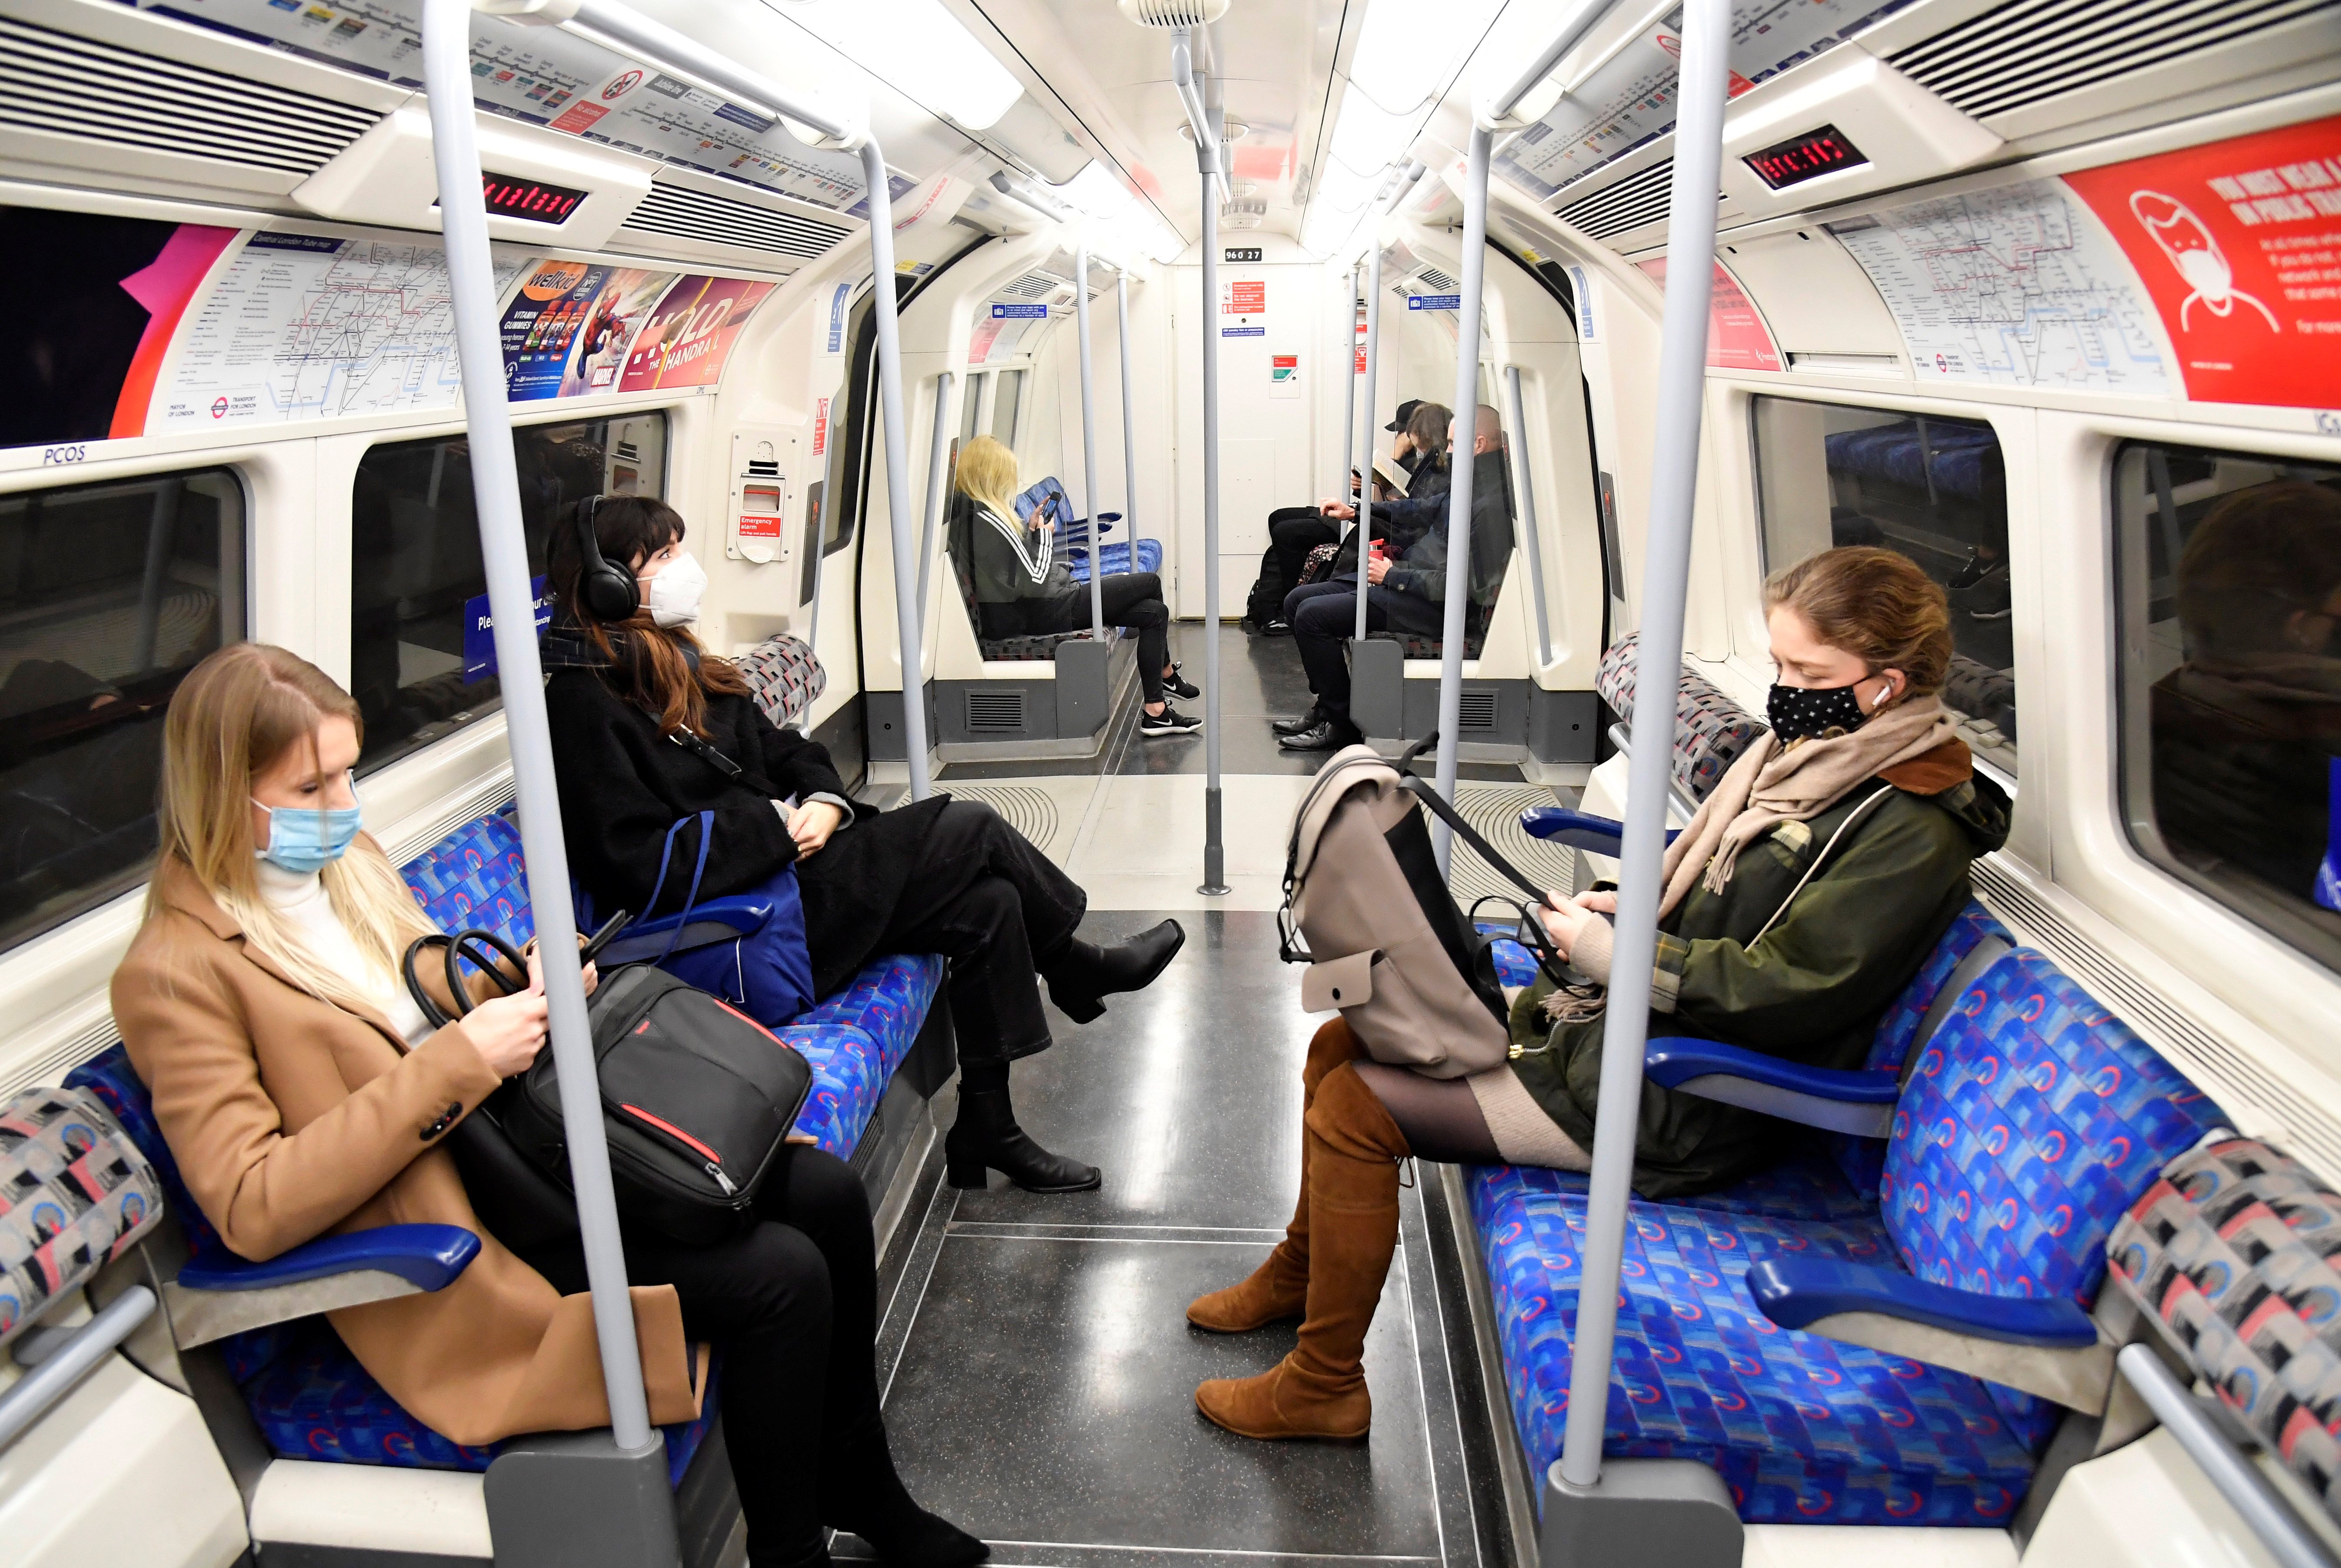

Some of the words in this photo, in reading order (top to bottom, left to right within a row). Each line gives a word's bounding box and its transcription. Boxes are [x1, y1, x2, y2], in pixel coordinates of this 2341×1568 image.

[514, 311, 539, 319] VITAMIN
[504, 321, 532, 329] GUMMIES
[648, 359, 661, 371] THE
[44, 445, 85, 465] PCOS
